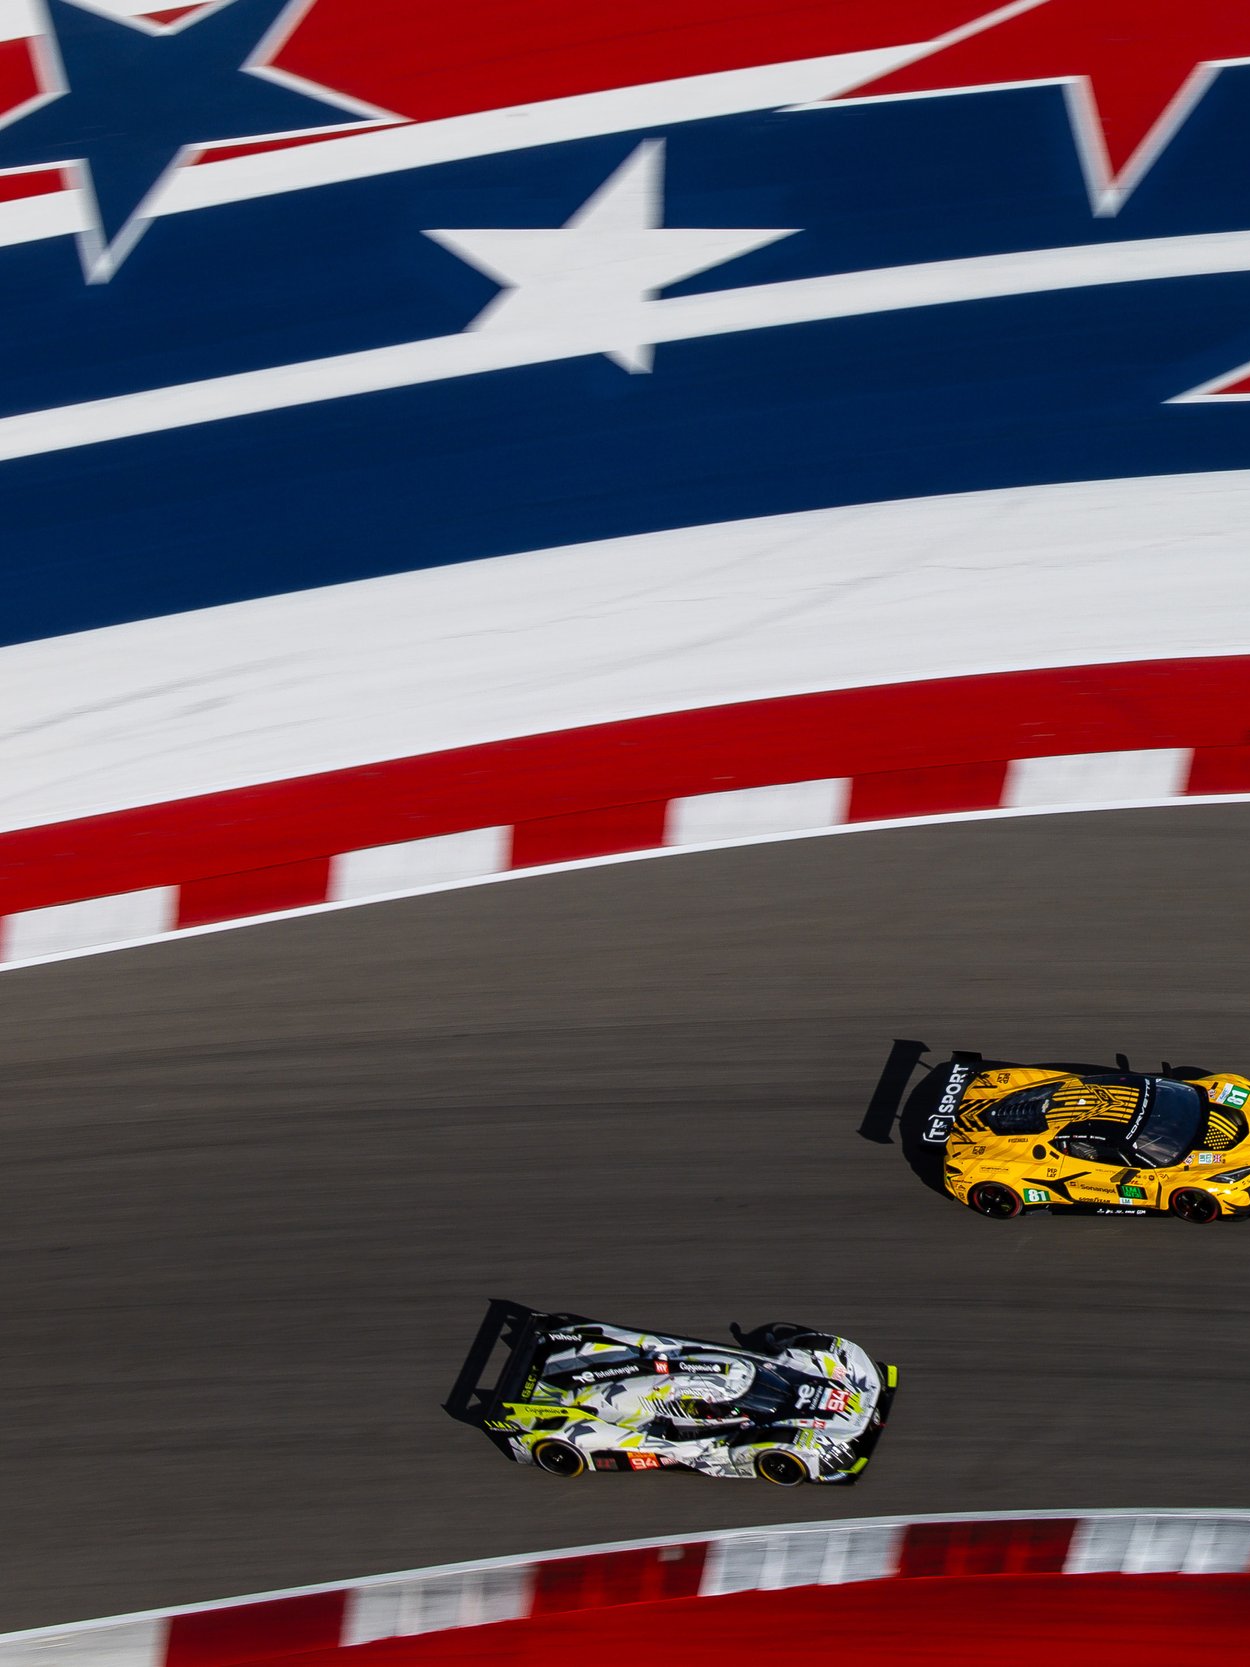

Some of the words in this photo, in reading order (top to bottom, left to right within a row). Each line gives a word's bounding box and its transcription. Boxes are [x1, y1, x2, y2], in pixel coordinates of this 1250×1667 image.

[938, 1064, 969, 1113] SPORT
[1226, 1089, 1248, 1106] 81
[1125, 1078, 1151, 1140] CORVETTE
[1028, 1189, 1048, 1202] 81
[1080, 1184, 1116, 1194] Sonangol
[594, 1365, 640, 1379] TotalEnergies
[679, 1362, 714, 1373] Capgemini
[827, 1389, 850, 1412] 94
[631, 1457, 659, 1470] 94
